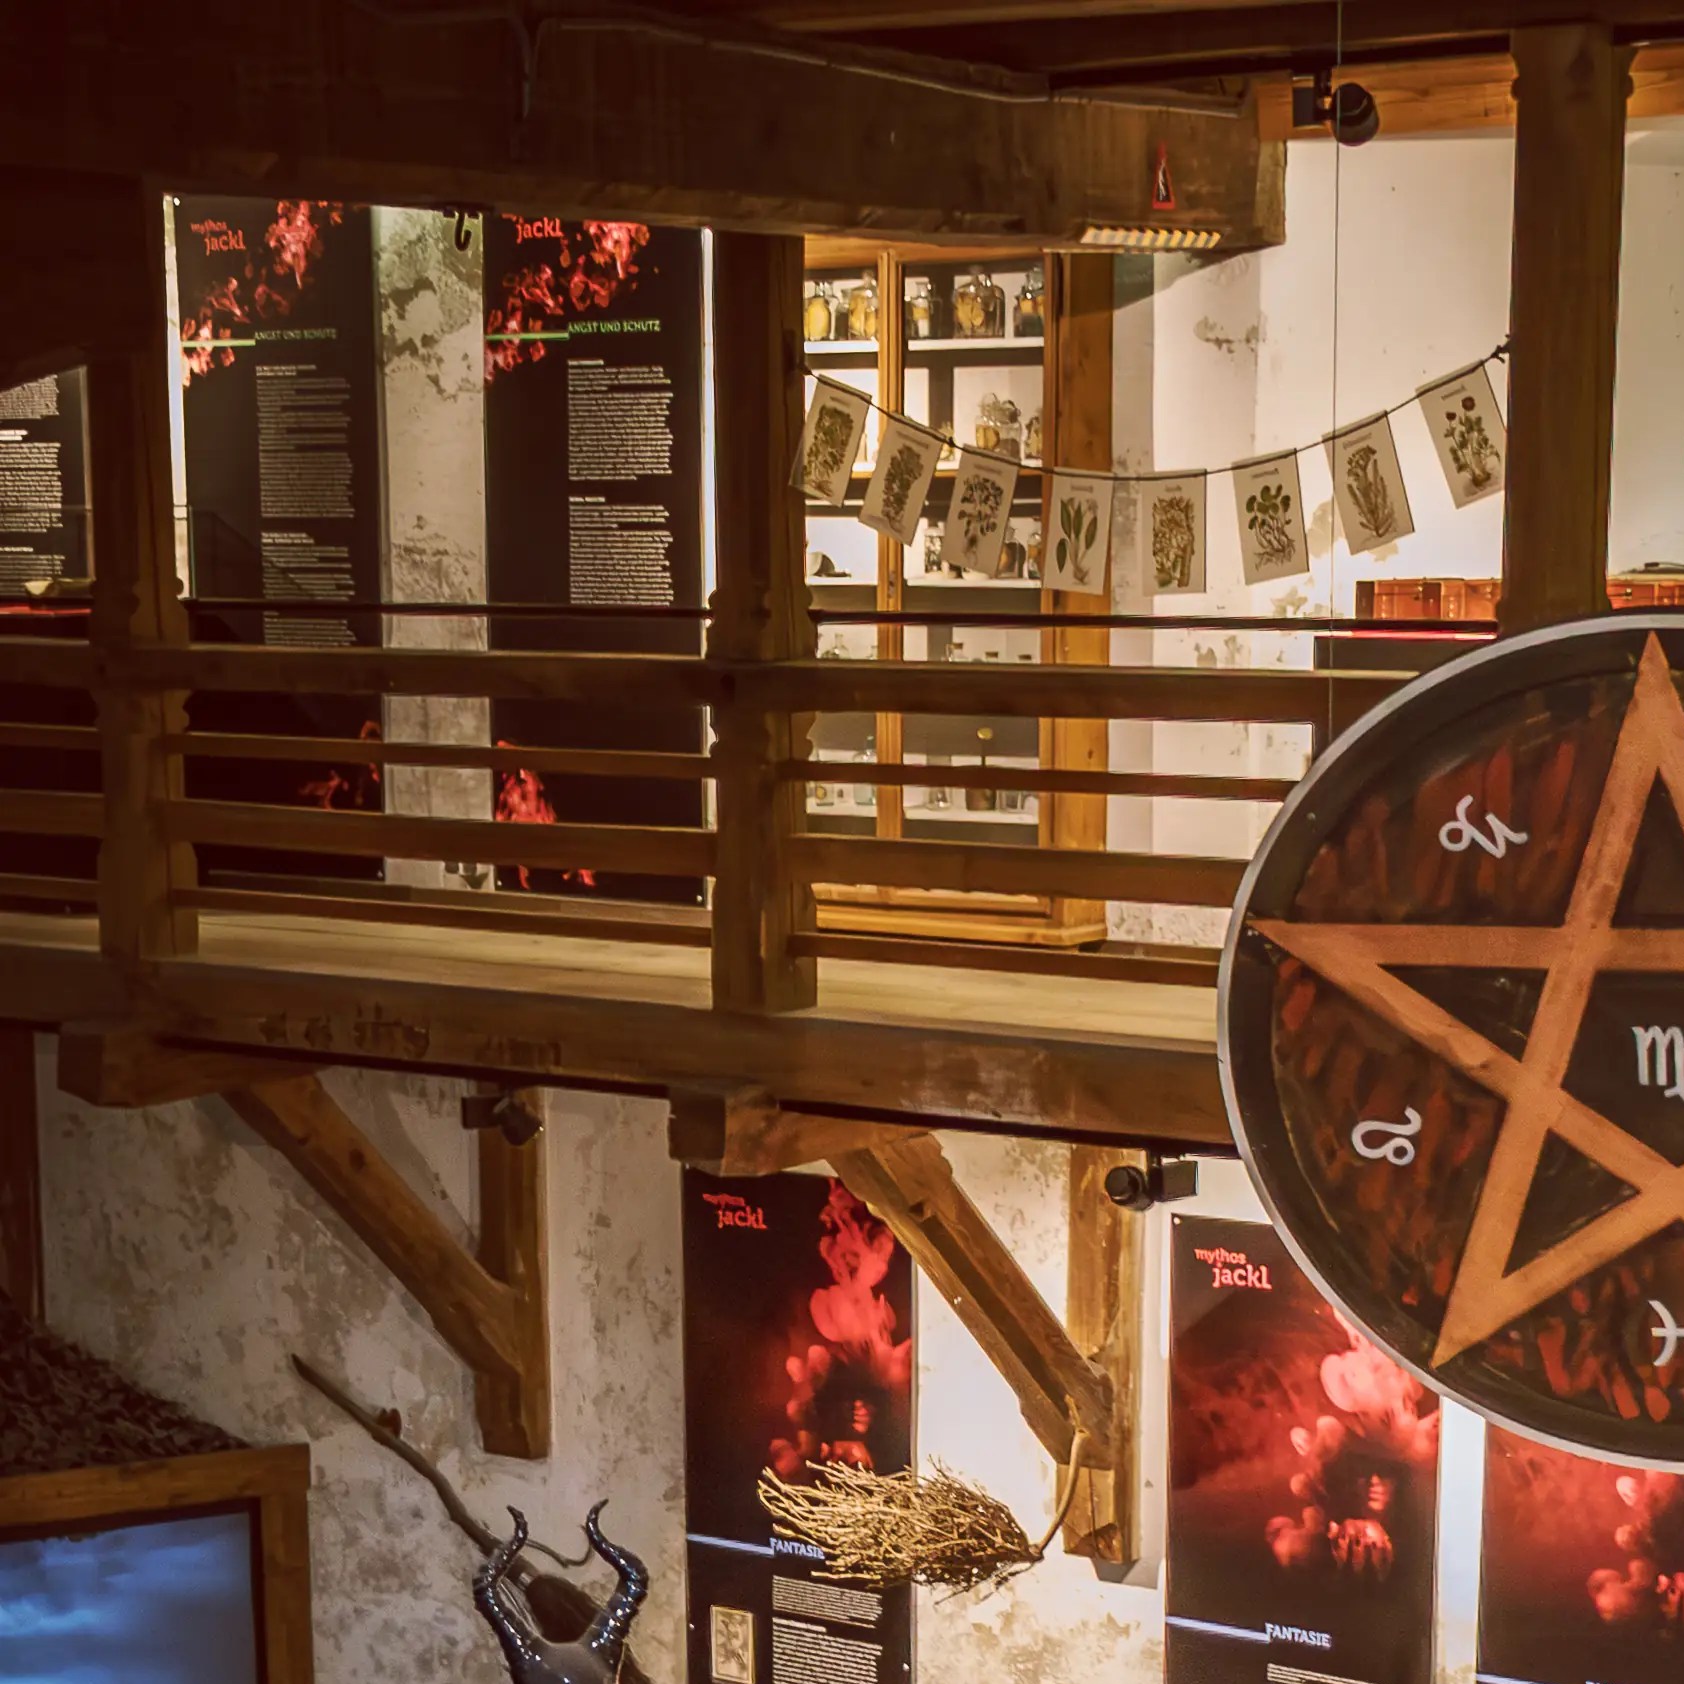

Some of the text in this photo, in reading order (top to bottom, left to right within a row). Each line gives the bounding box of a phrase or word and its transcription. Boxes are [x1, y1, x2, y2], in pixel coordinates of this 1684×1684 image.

[204, 229, 246, 256] jackl
[516, 216, 564, 243] jackl
[569, 320, 660, 333] ANGST UND SCHUTZ
[1194, 1247, 1247, 1265] mythos
[1212, 1262, 1272, 1290] jackl
[1265, 1622, 1332, 1648] FANTASIE
